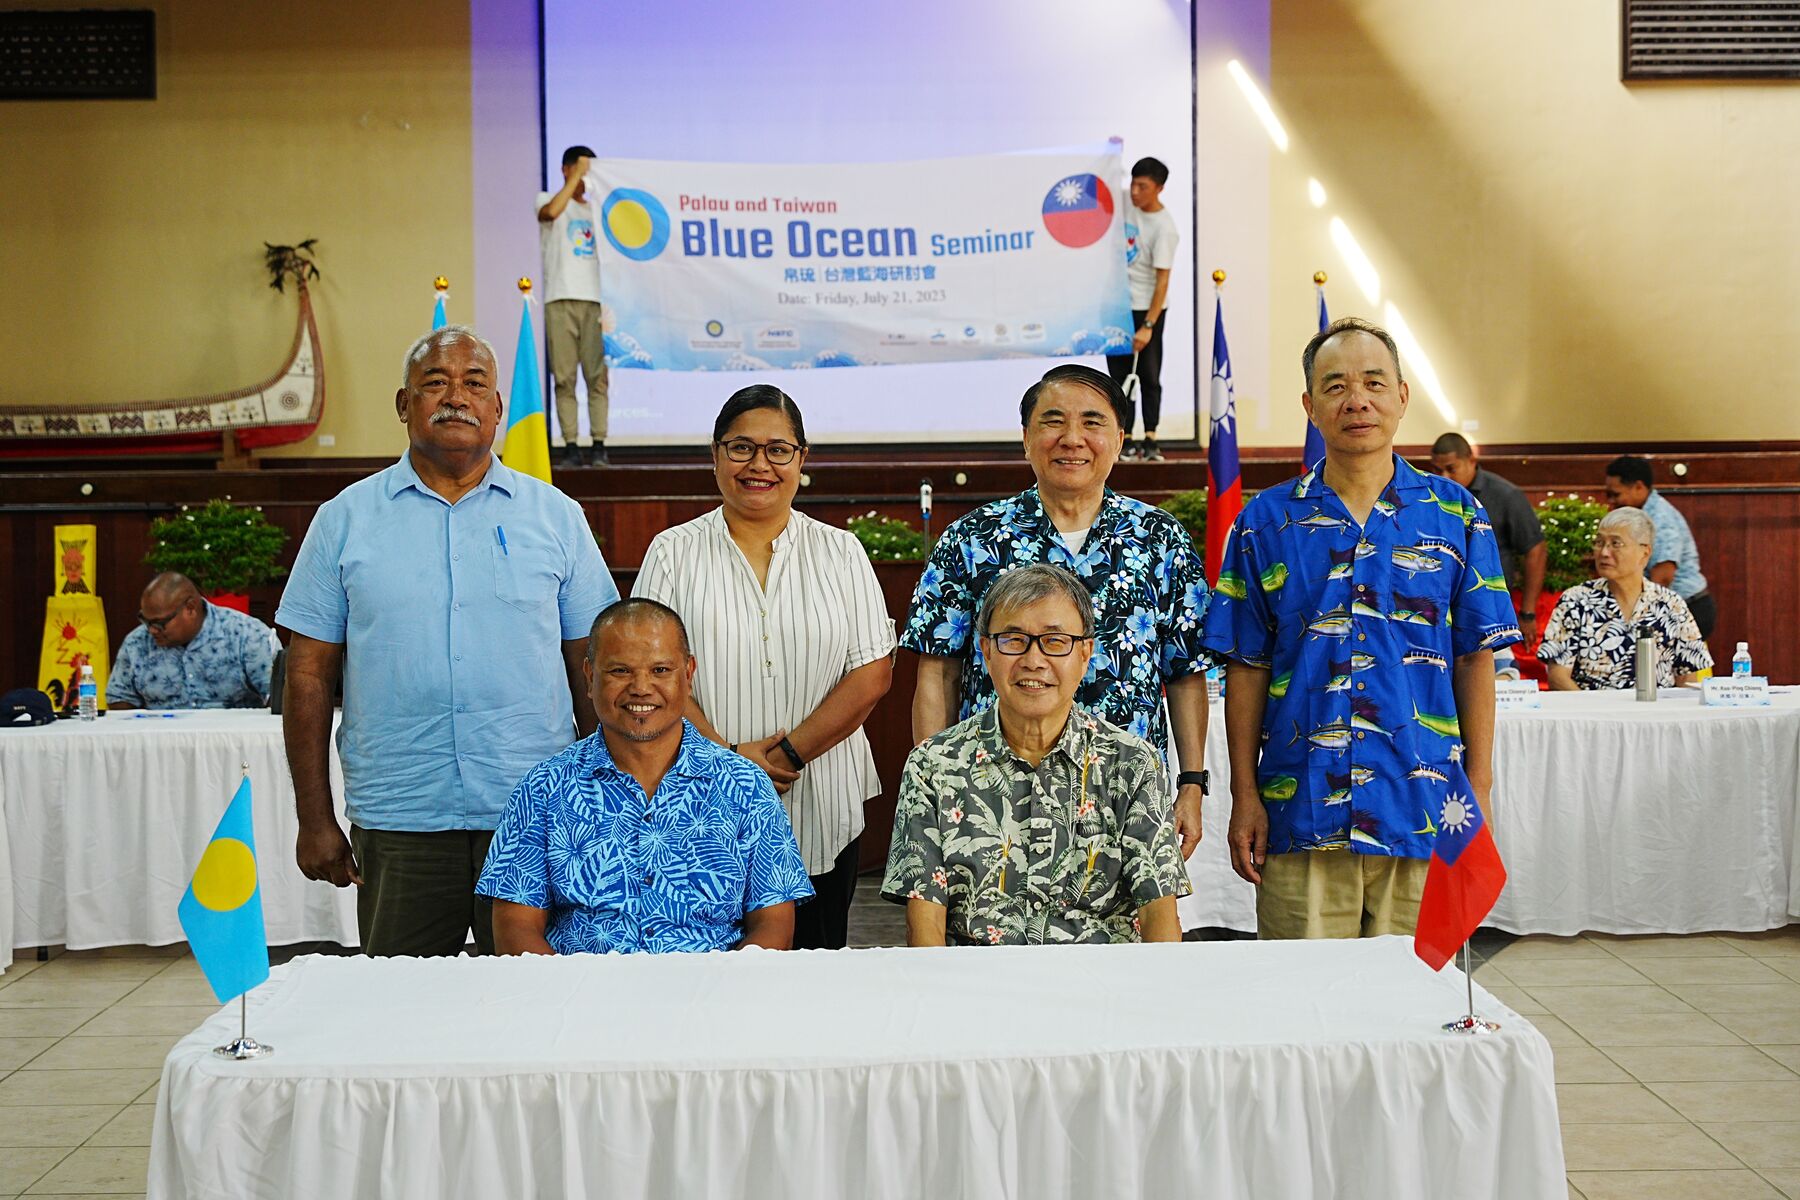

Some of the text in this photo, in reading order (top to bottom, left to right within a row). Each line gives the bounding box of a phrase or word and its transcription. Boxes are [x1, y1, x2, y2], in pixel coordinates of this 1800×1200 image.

[679, 194, 838, 214] Palau and Taiwan
[680, 218, 1036, 259] Blue Ocean Seminar
[777, 290, 947, 307] Date: Friday, July 21, 2023
